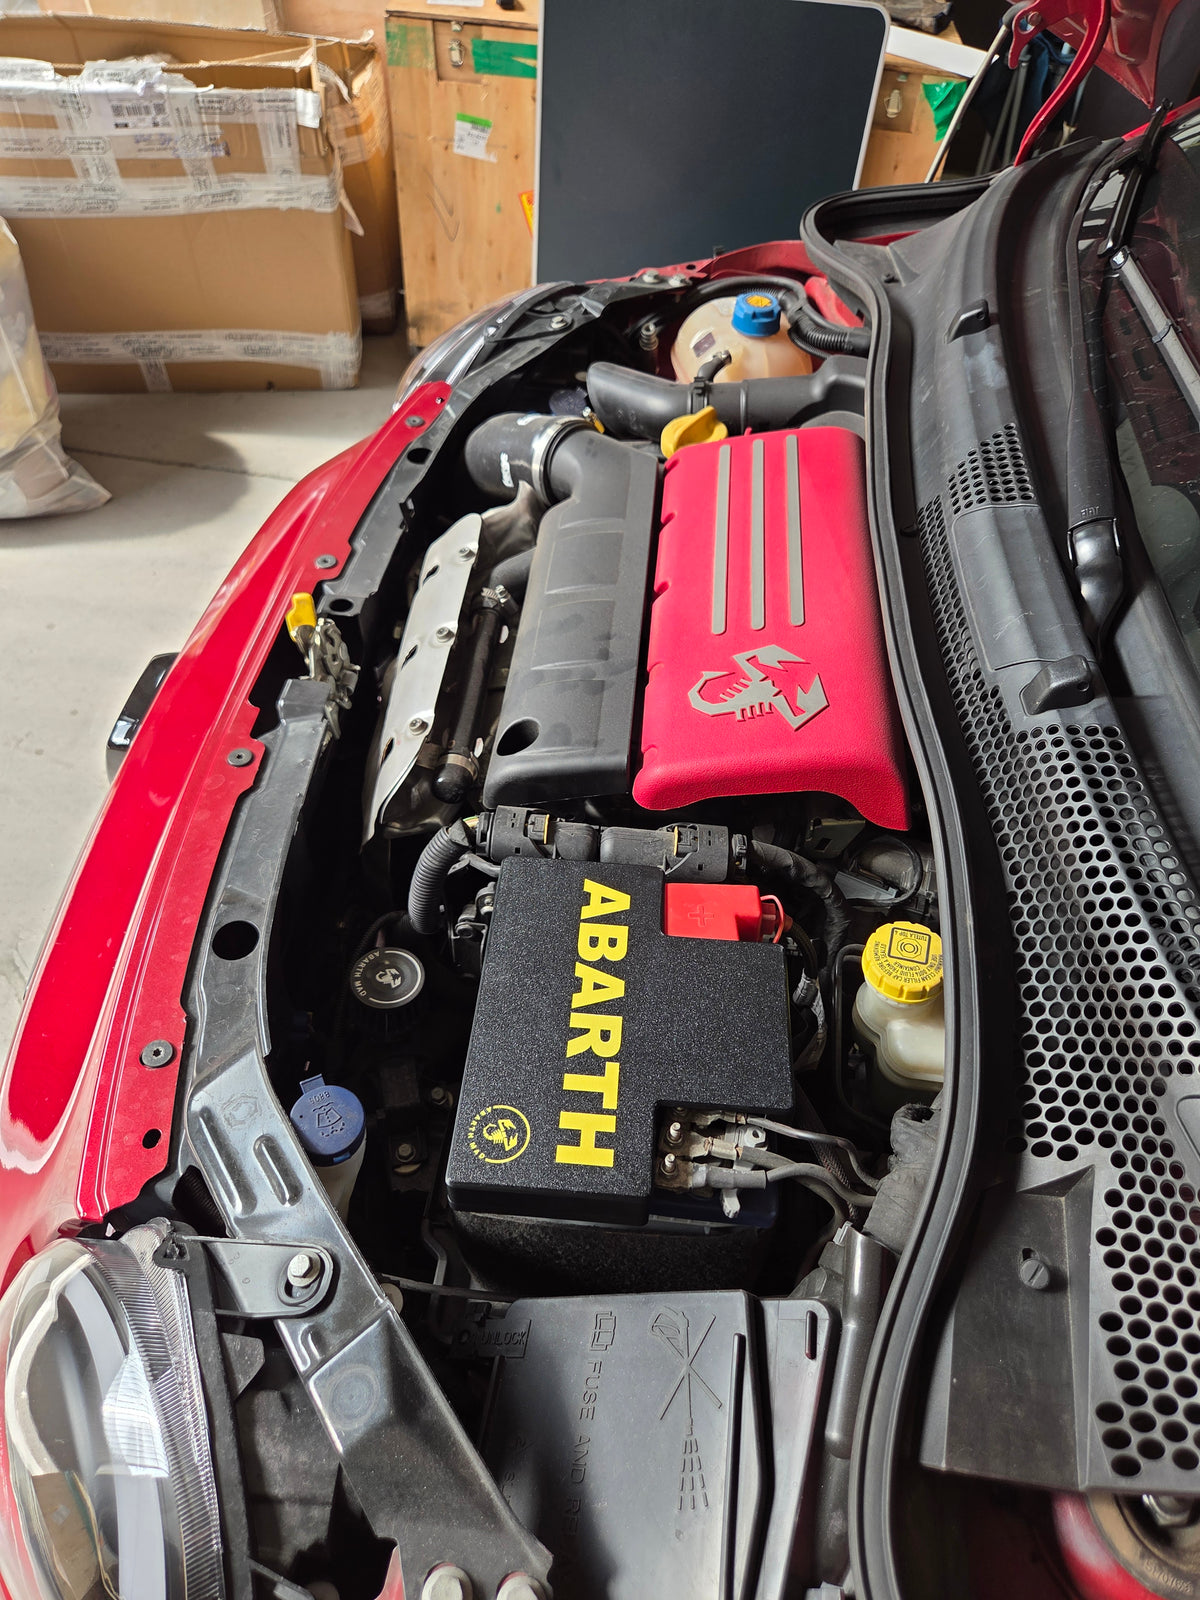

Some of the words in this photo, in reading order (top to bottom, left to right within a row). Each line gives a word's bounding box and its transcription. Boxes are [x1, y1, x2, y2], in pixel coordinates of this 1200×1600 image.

[1080, 506, 1100, 519] FIAT
[909, 933, 928, 941] TUTELA
[353, 951, 381, 978] ABARTH
[877, 961, 892, 977] BEFORE
[885, 962, 900, 974] FROM
[920, 973, 936, 982] CLEAN
[354, 980, 367, 997] MAD
[555, 878, 631, 1168] ABARTH
[467, 1106, 492, 1139] ABARTH
[469, 1141, 486, 1159] MAD
[481, 1330, 527, 1346] UNLOCK
[579, 1360, 603, 1421] FUSE
[570, 1434, 592, 1485] AND
